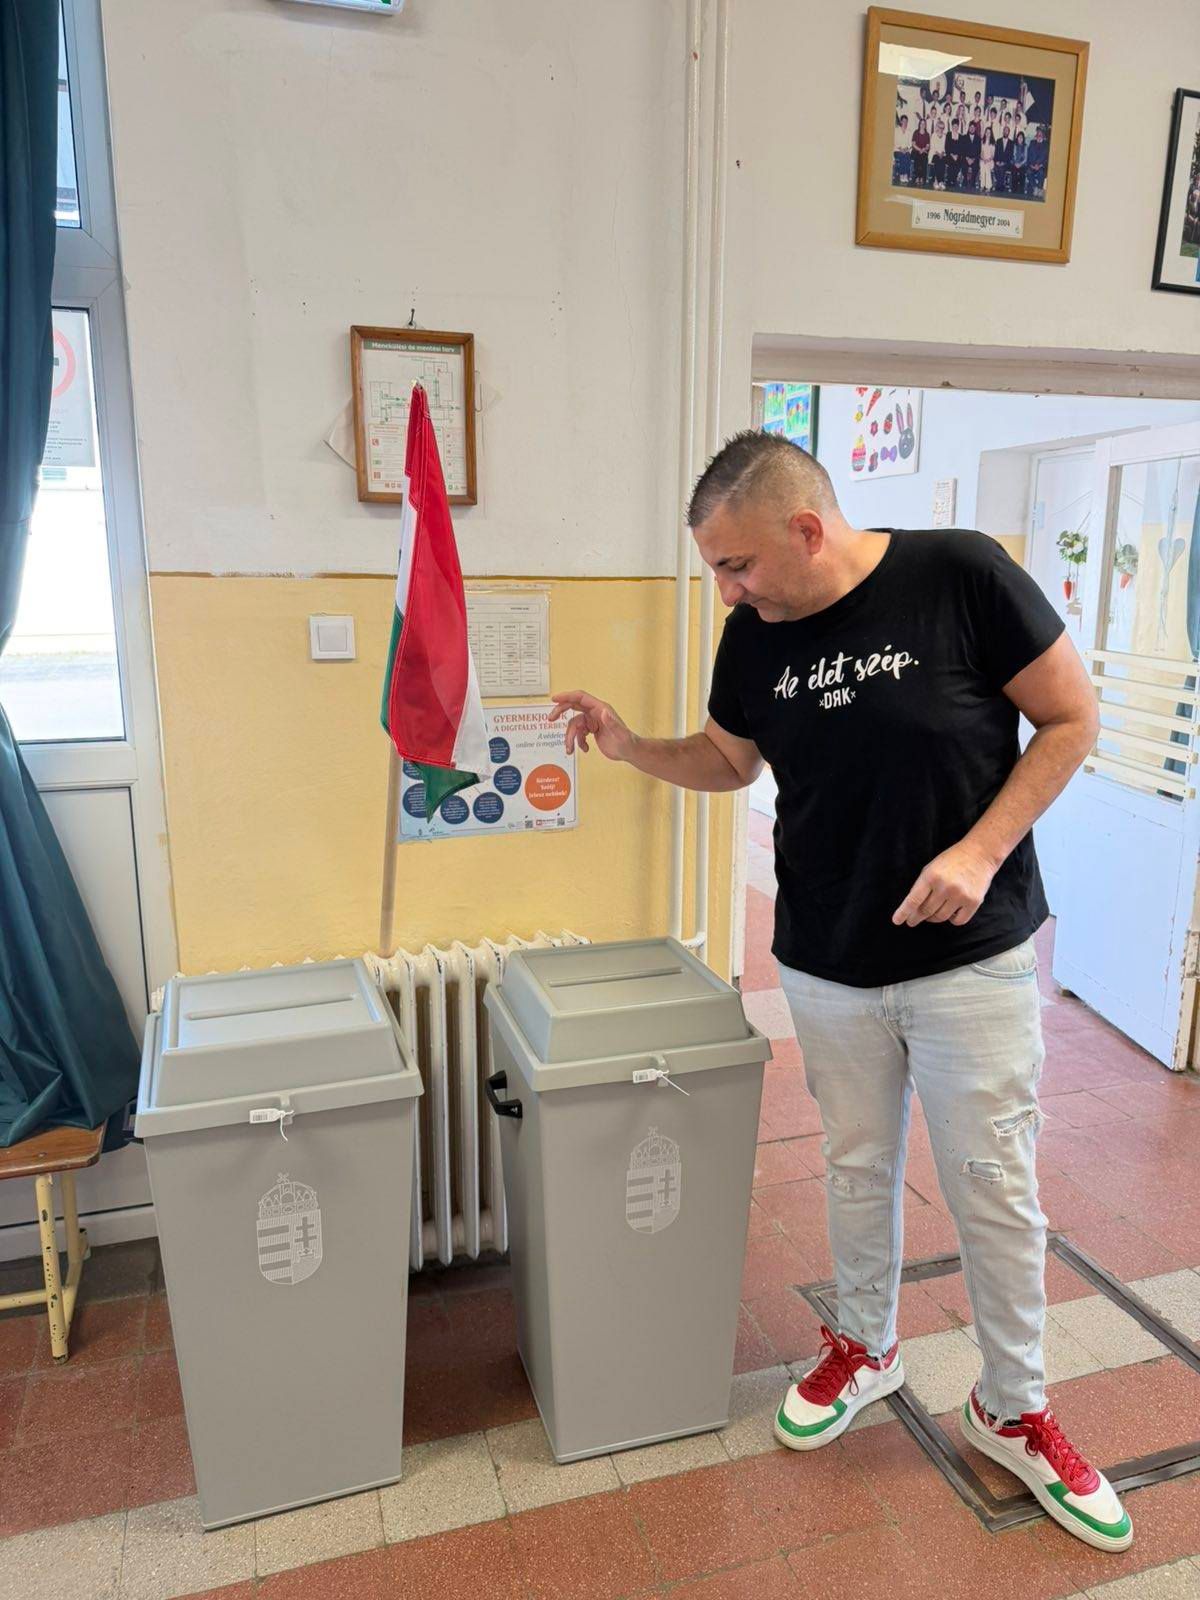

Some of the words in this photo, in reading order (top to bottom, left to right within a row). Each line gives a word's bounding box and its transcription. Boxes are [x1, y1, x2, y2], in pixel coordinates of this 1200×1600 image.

[927, 211, 941, 220] 1996
[944, 208, 997, 228] Nógrádmegyer
[997, 218, 1011, 227] 2004
[416, 344, 442, 352] mentési
[773, 665, 800, 699] Az
[807, 651, 853, 690] élet
[854, 644, 920, 682] szép.
[493, 712, 568, 723] GYERMEKJOK
[501, 723, 538, 732] DIGITÁLIS
